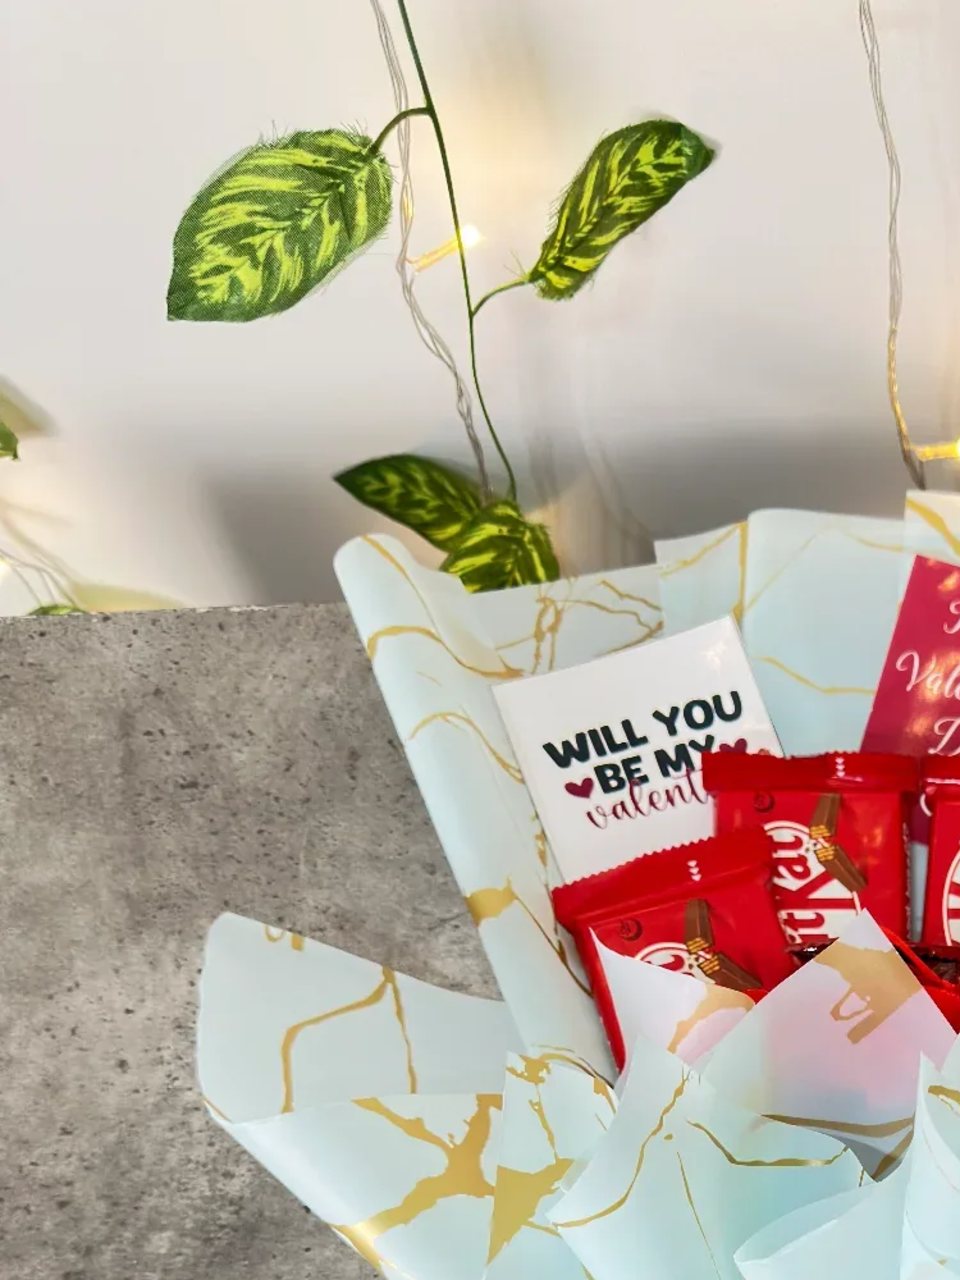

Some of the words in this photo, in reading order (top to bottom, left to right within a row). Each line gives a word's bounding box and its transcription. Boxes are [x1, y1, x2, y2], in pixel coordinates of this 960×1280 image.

[542, 719, 648, 769] WILL
[652, 690, 743, 736] YOU
[593, 755, 649, 794] BE
[654, 734, 715, 778] MY
[586, 766, 713, 829] valent
[771, 836, 855, 943] itKat
